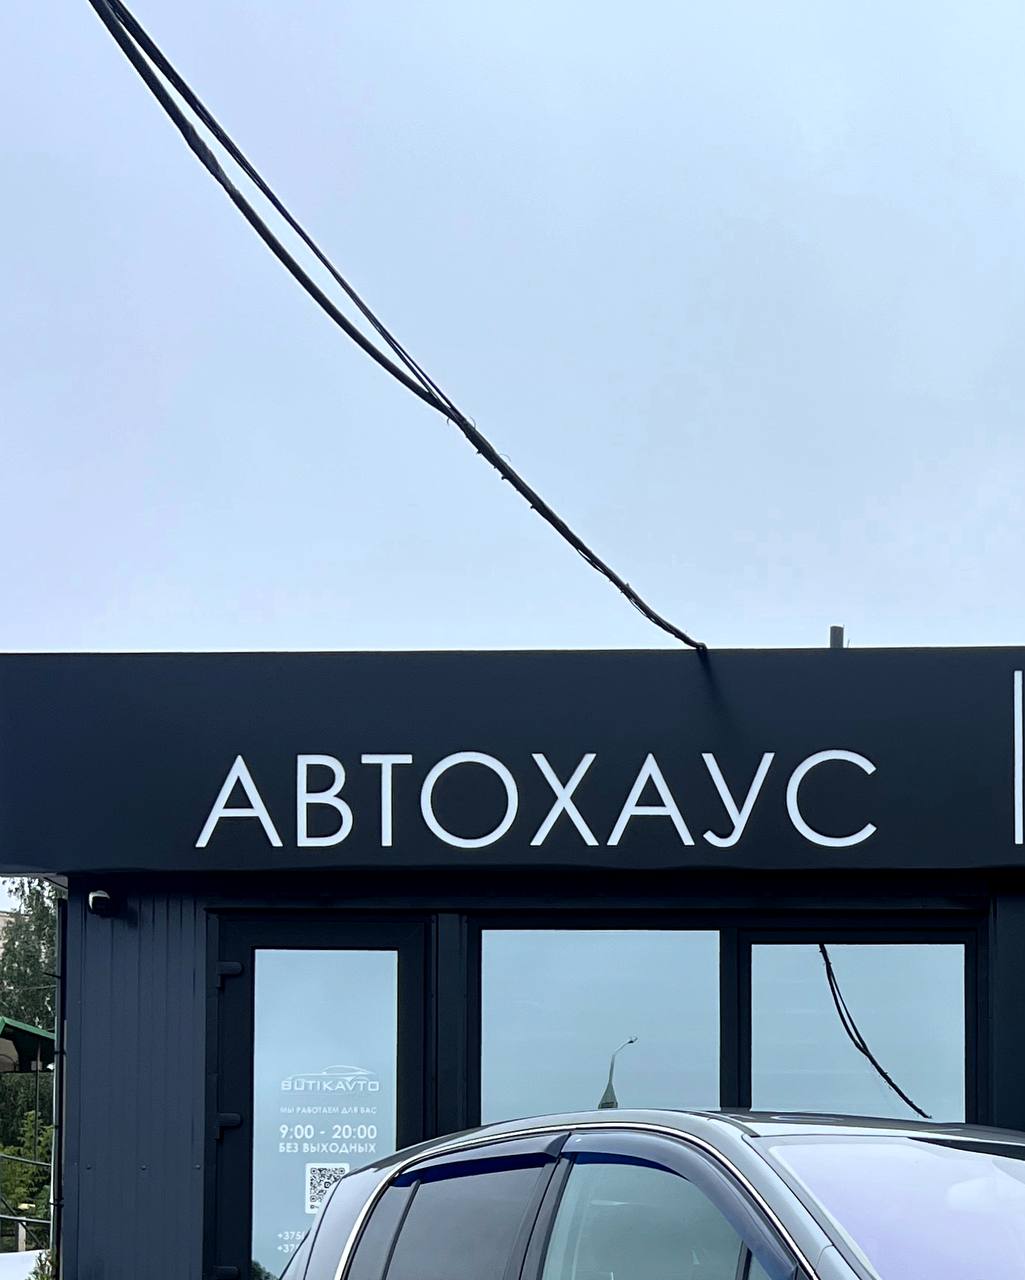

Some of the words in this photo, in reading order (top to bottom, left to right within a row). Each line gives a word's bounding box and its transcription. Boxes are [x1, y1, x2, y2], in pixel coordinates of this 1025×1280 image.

[195, 748, 878, 849] АВТОХАУС
[280, 1079, 380, 1092] BUTIKAVTO
[279, 1124, 314, 1139] 9:00
[332, 1124, 377, 1139] 20:00
[278, 1143, 299, 1153] БЕЗ
[302, 1142, 377, 1153] ВЫХОДНЫХ
